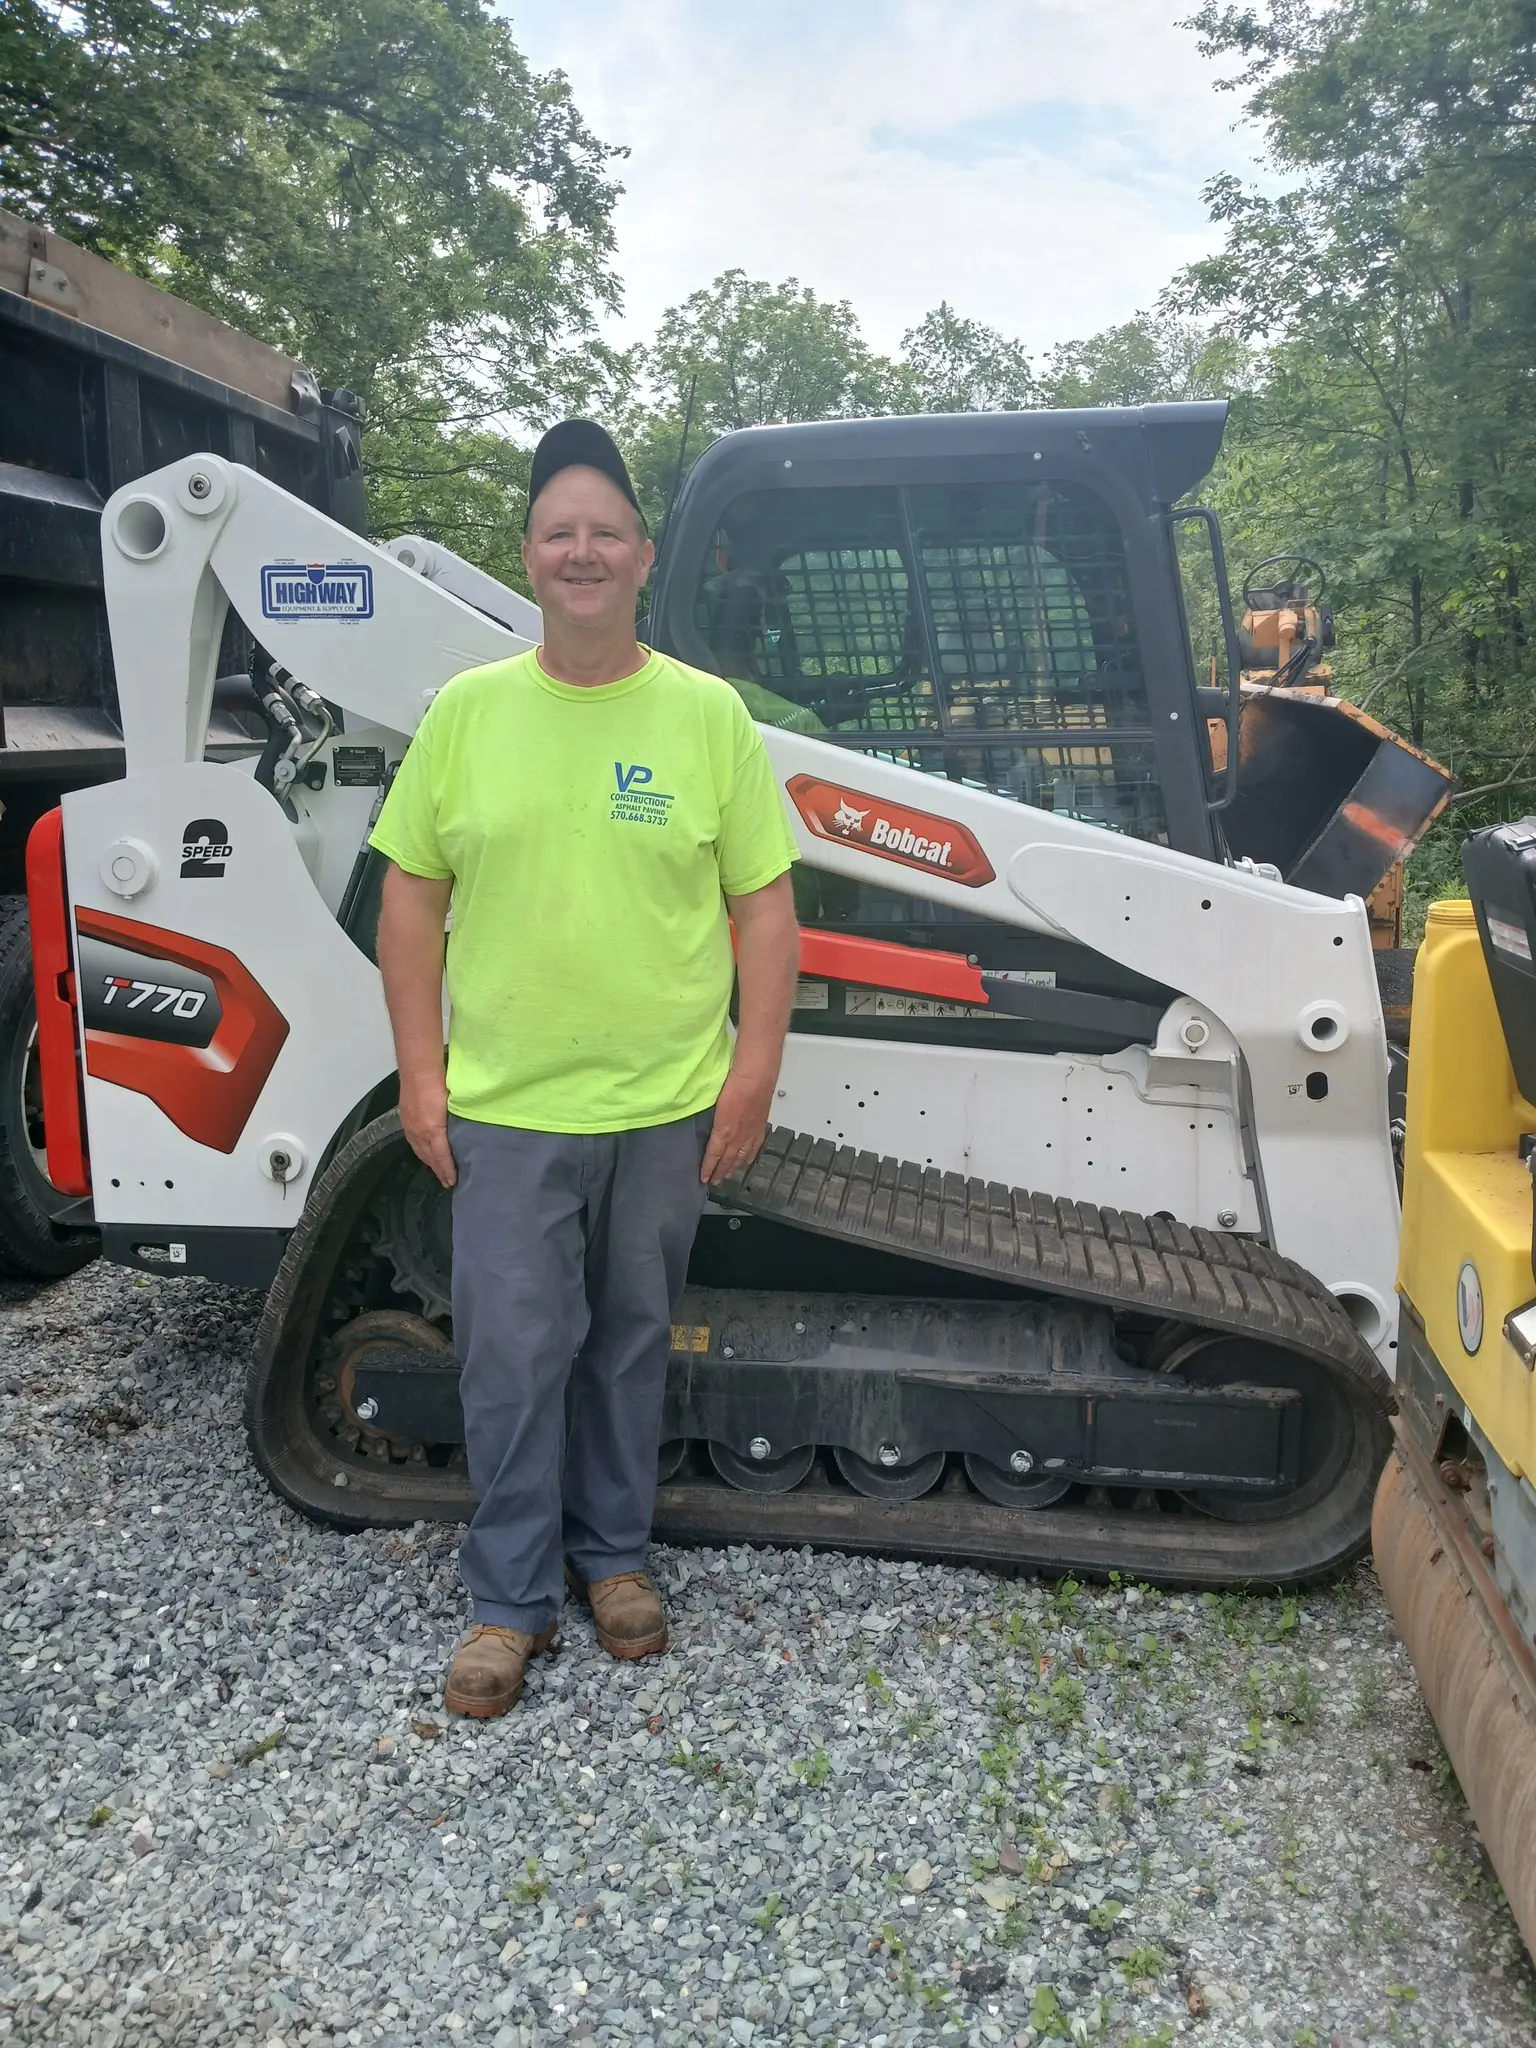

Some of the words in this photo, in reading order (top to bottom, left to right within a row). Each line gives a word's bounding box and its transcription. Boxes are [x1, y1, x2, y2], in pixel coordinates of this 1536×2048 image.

[275, 582, 357, 604] HIGHWAY
[614, 762, 653, 792] VP
[610, 793, 666, 807] CONSTRUCTION
[615, 803, 641, 812] ASPHALT
[642, 807, 666, 816] PAVING
[610, 810, 668, 826] 570.668.3737
[180, 818, 228, 878] 2
[181, 846, 232, 858] SPEED
[870, 818, 953, 866] Bobcat
[103, 976, 207, 1018] T770
